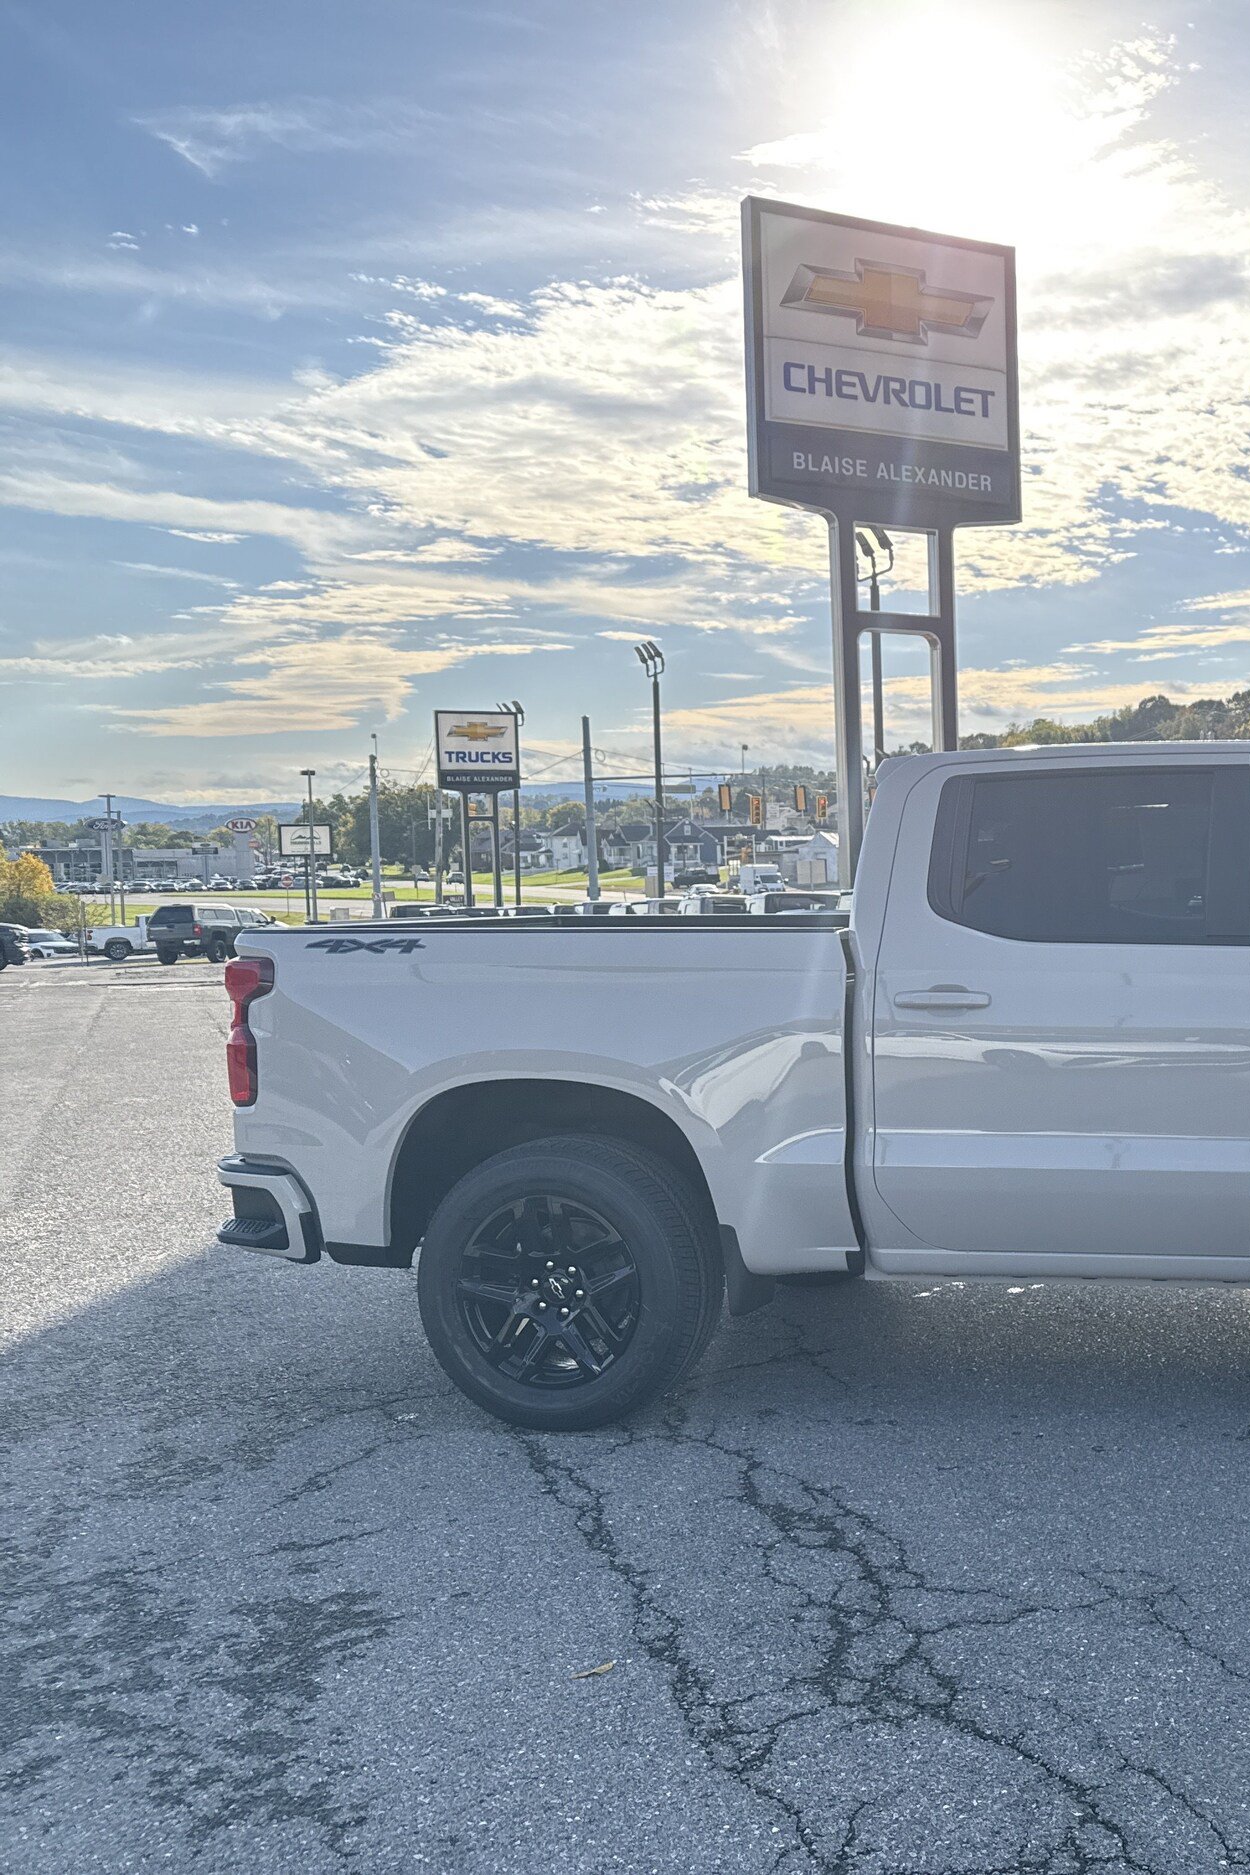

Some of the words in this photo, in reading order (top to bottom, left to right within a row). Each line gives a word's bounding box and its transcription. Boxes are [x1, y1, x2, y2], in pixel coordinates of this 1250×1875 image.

[783, 361, 995, 418] CHEVROLET
[793, 452, 868, 477] BLAISE
[876, 462, 992, 492] ALEXANDER
[444, 751, 513, 763] TRUCKS
[231, 821, 253, 830] KIA
